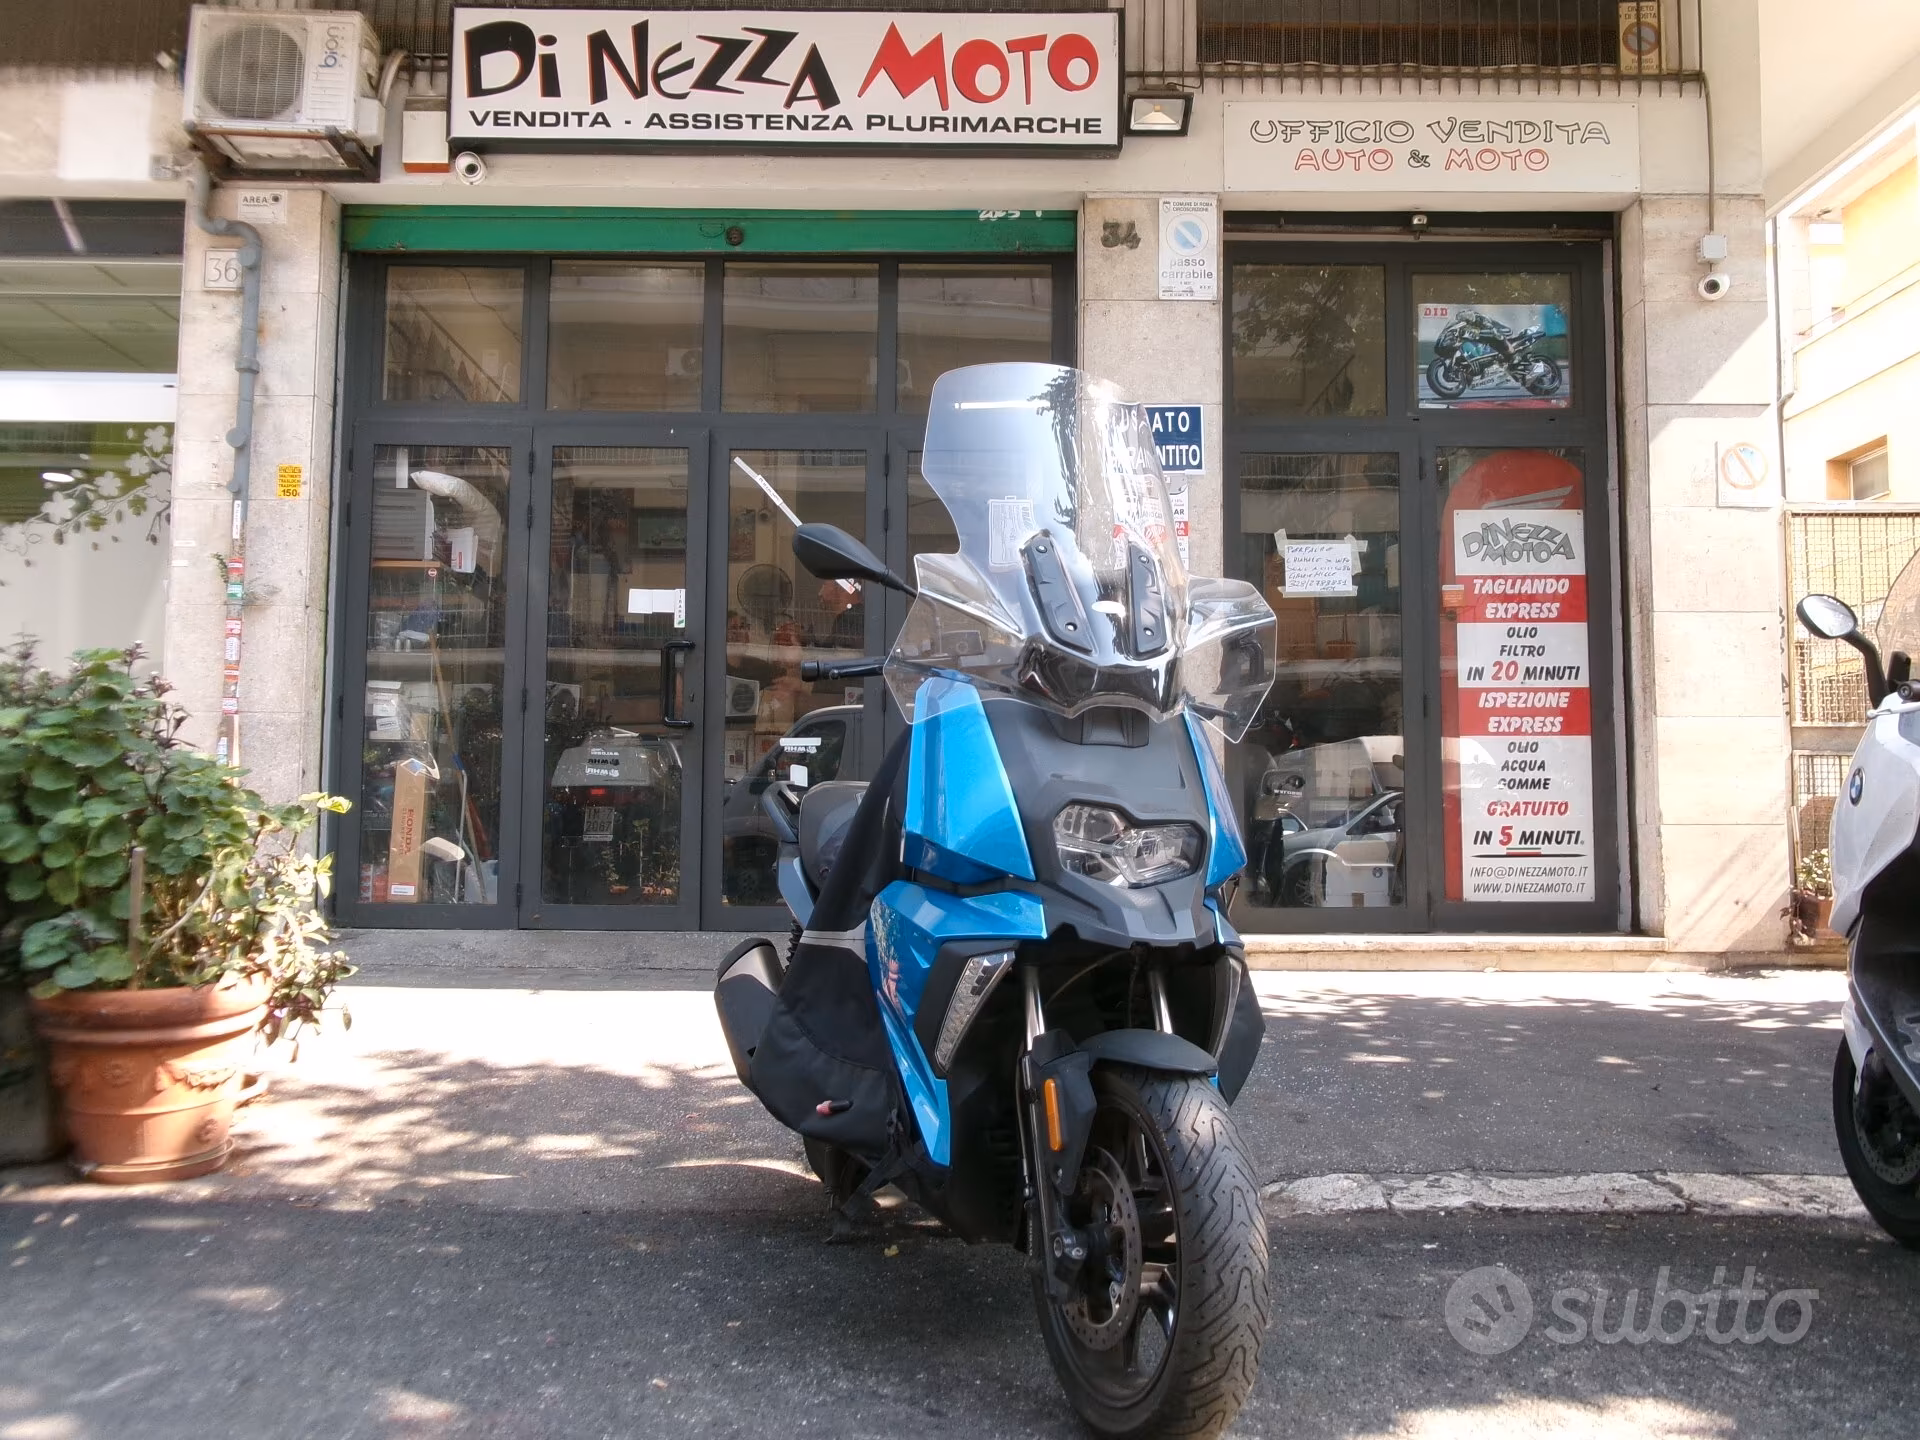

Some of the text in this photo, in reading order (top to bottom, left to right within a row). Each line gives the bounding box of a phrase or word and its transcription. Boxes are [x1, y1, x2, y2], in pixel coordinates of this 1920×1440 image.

[857, 20, 1099, 111] MOTO
[469, 110, 612, 128] VENDITA
[644, 112, 854, 131] ASSISTENZA
[866, 114, 1102, 134] PLURIMARCHE
[1250, 116, 1611, 145] UFFICIO VENDITA
[1295, 148, 1550, 171] AUTO & MOTO
[242, 196, 268, 204] AREA
[207, 257, 239, 282] 36
[1169, 258, 1206, 270] passo
[1161, 269, 1214, 280] carrabile
[1481, 540, 1552, 566] MOTO
[1473, 579, 1570, 595] TAGLIANDO
[1485, 603, 1560, 620] EXPRESS
[1507, 627, 1538, 638] OLIO
[1500, 645, 1546, 657] FILTRO
[1467, 660, 1580, 681] IN 20 MINUTI
[1478, 692, 1570, 708] ISPEZIONE
[1488, 716, 1564, 733] EXPRESS
[1507, 741, 1539, 753] OLIO
[1500, 760, 1546, 773] ACQUA
[1498, 778, 1551, 790] GOMME
[1487, 801, 1569, 817] GRATUITO
[405, 808, 415, 856] HONDA
[1473, 826, 1581, 846] IN 5 MINUTI
[1470, 867, 1588, 879] INFO@DINEZZAMOTO.IT
[1473, 883, 1585, 894] WWW.DINEZZAMOTO.IT
